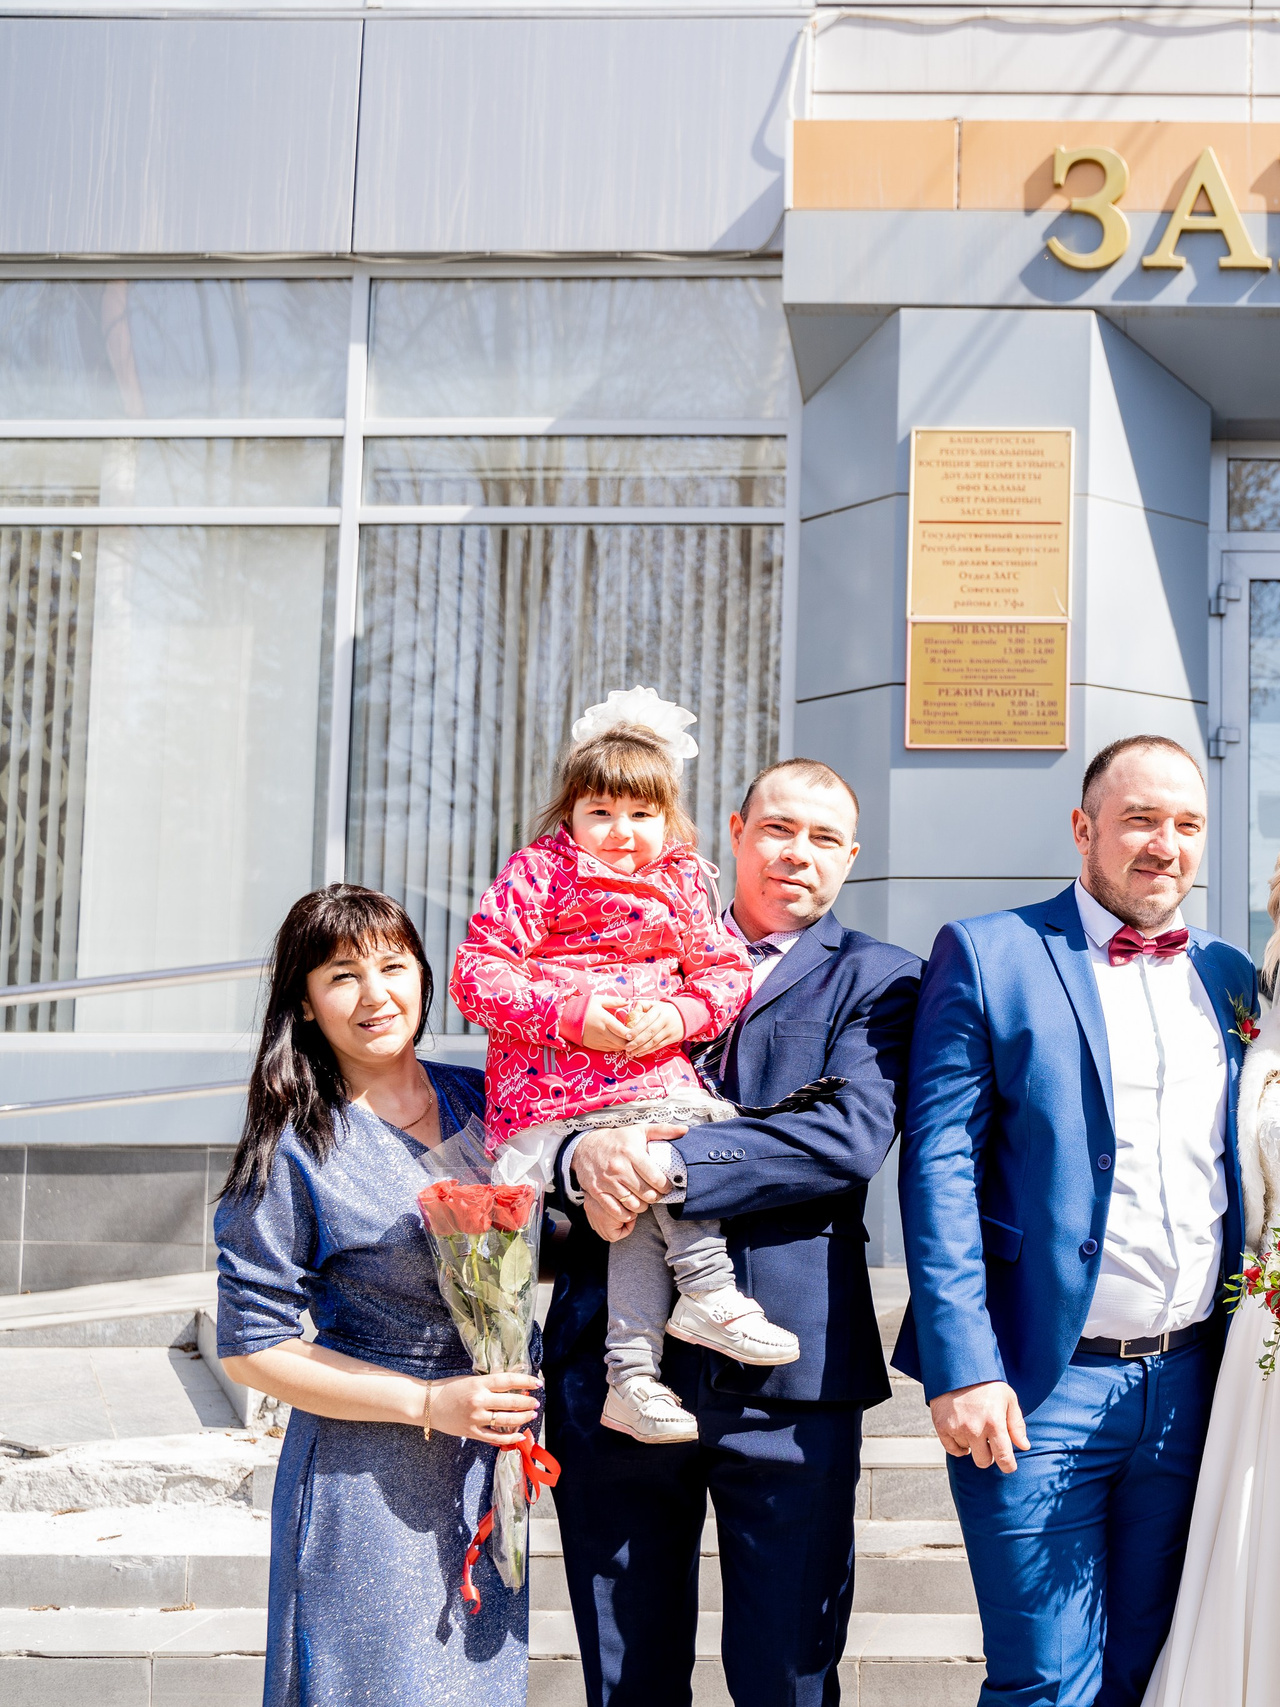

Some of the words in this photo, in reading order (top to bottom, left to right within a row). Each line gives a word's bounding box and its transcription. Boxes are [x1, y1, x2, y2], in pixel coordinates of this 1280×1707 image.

[922, 531, 1012, 541] Государственный
[1016, 532, 1058, 540] комитет
[921, 545, 981, 553] Республики
[985, 545, 1060, 554] Башкортостан
[959, 572, 990, 580] Отдел
[960, 585, 1018, 593] Советского
[954, 599, 991, 609] района
[1004, 599, 1024, 610] Уфа
[938, 688, 983, 696] РЕЖИМ
[987, 688, 1039, 697] РАБОТЫ:
